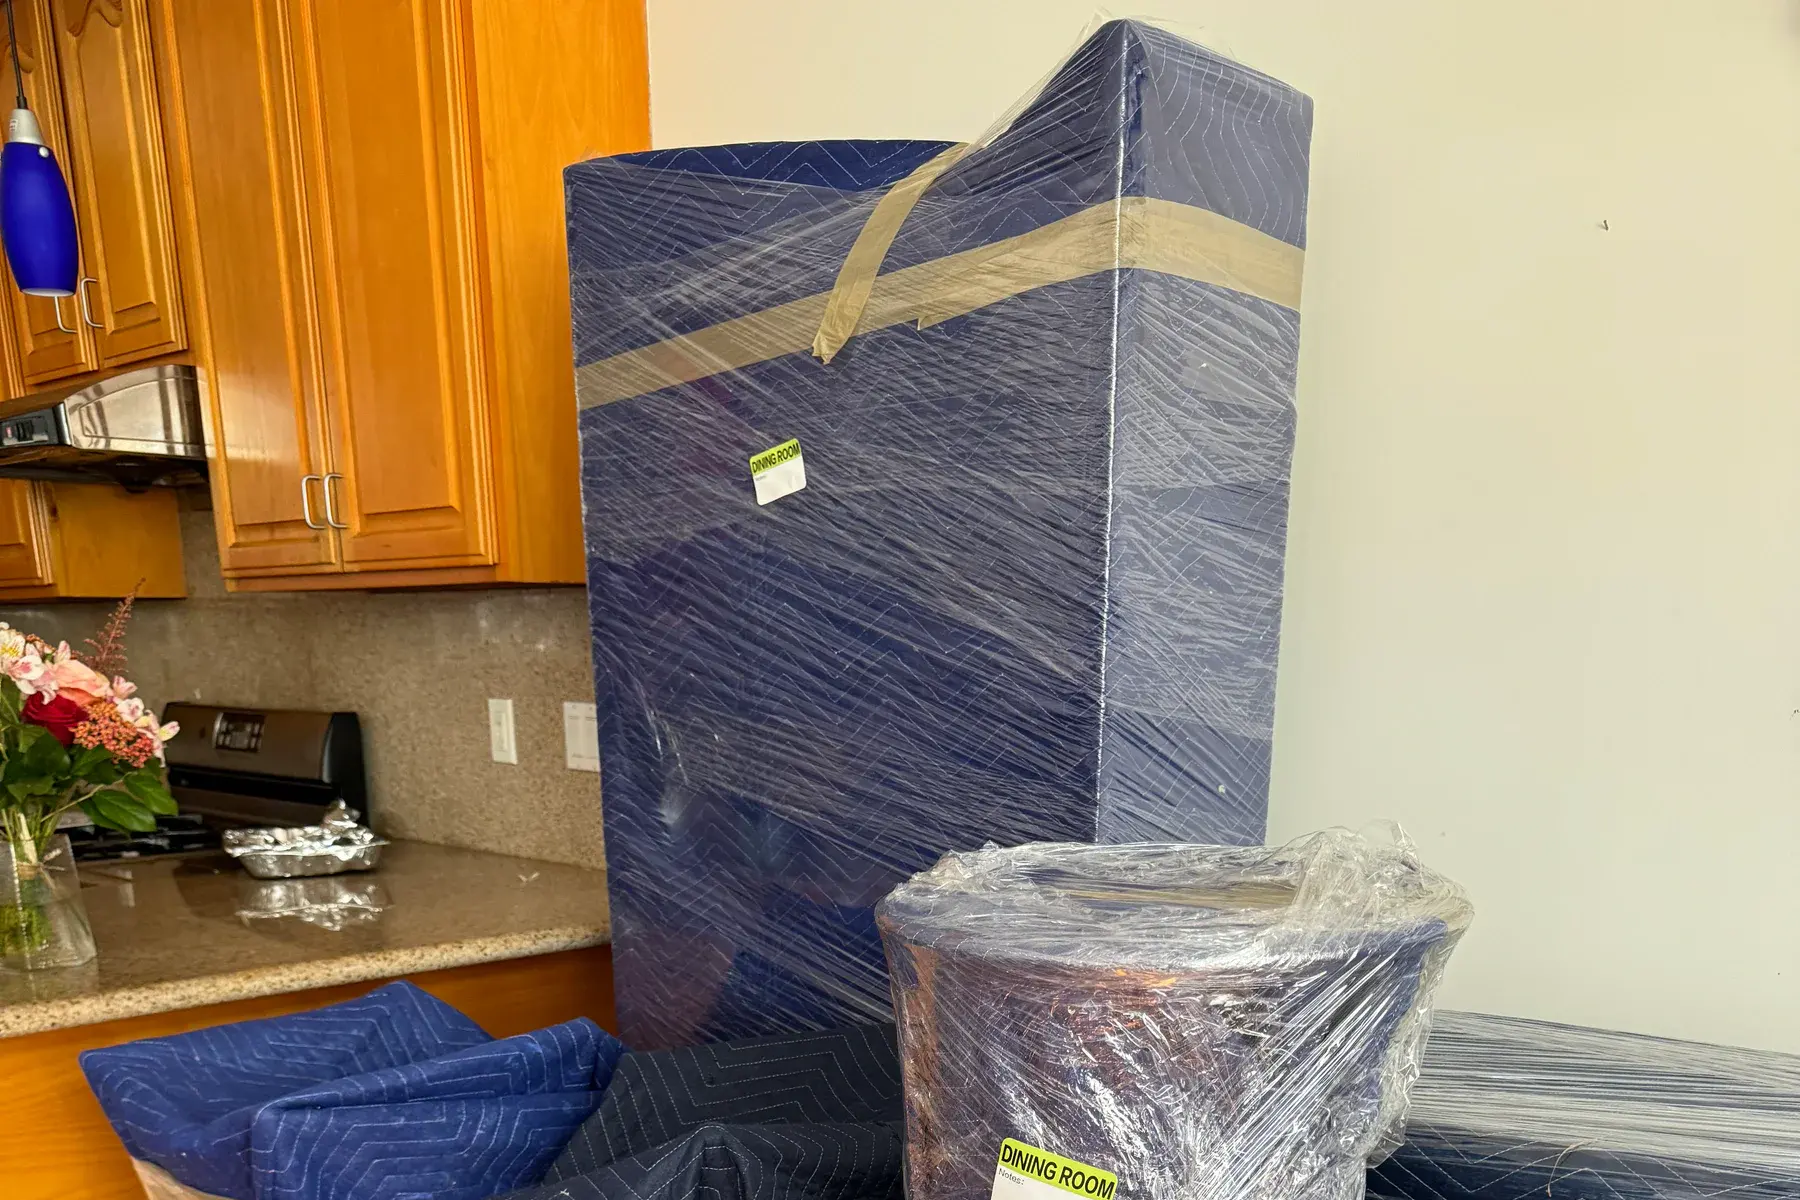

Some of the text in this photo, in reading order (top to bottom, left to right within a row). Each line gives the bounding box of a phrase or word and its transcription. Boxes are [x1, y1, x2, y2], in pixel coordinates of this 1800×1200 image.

[752, 442, 800, 473] DINING ROOM
[998, 1167, 1025, 1186] Notes:
[1001, 1144, 1115, 1200] DINING ROOM
